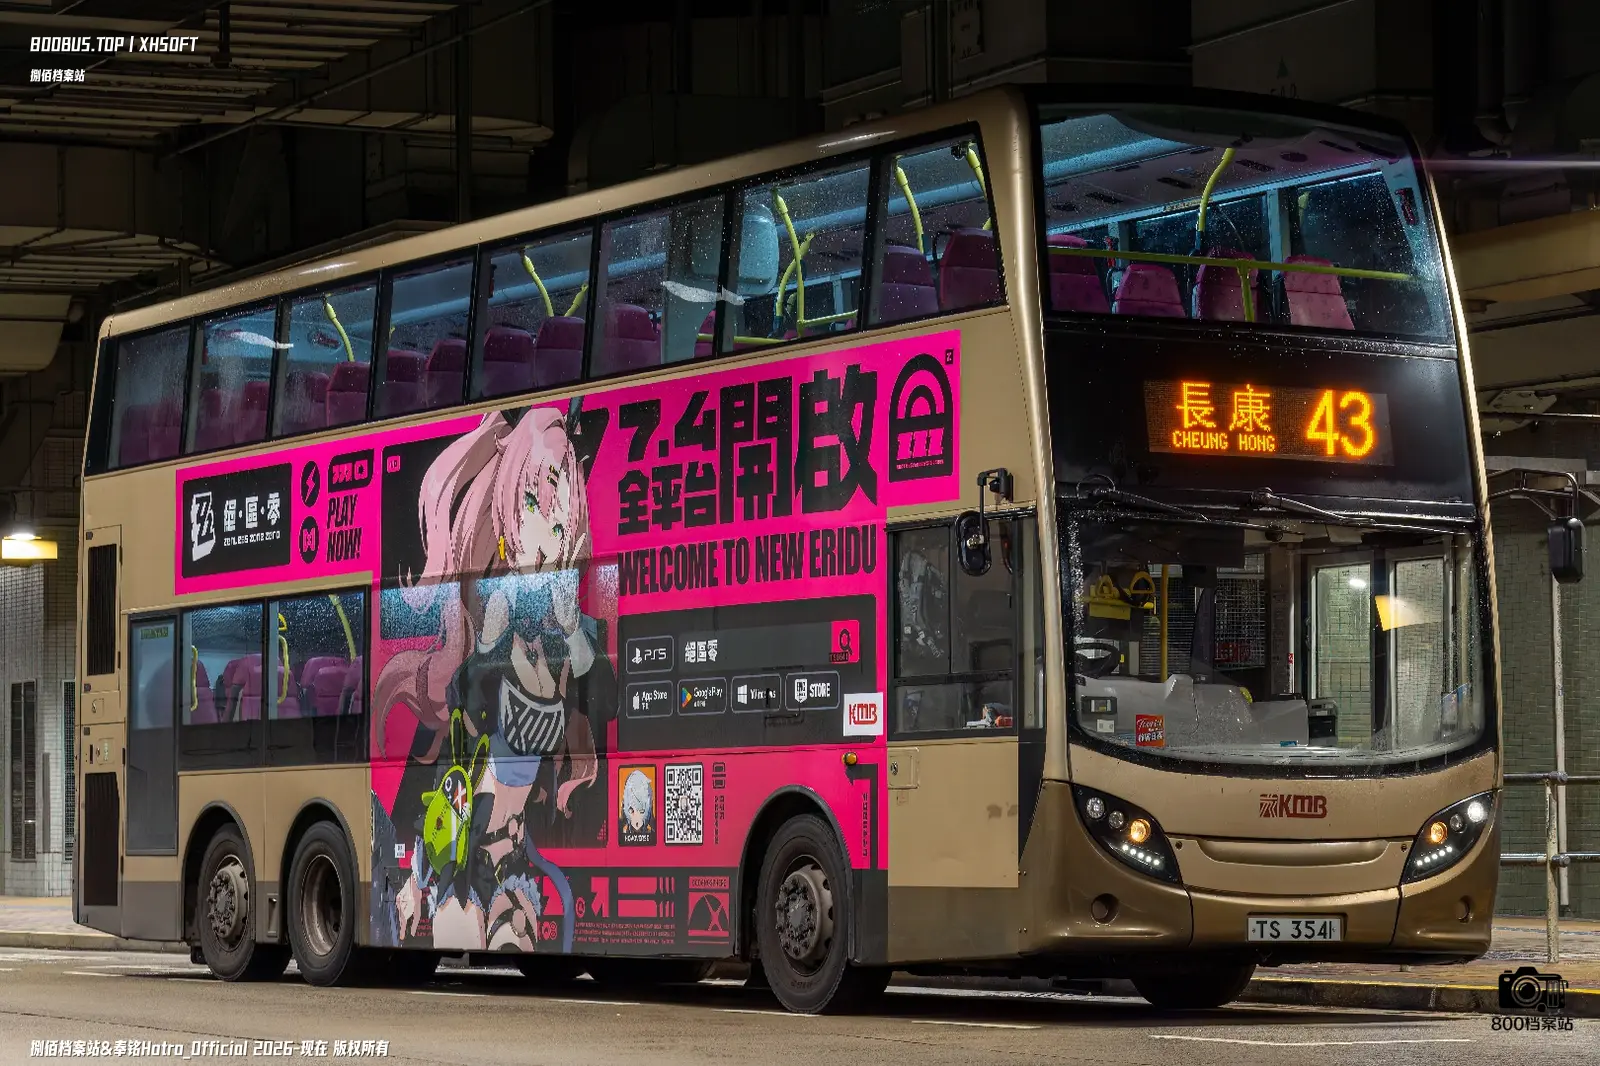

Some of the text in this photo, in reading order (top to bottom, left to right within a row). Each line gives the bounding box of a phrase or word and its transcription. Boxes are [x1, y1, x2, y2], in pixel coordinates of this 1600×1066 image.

[1176, 382, 1271, 432] 長康
[618, 390, 716, 463] 7.4
[1306, 389, 1374, 456] 43
[1172, 430, 1276, 452] CHEUNG HONG
[618, 461, 717, 536] 全平台
[327, 494, 358, 529] PLAY
[326, 527, 362, 563] NOW!
[617, 523, 877, 597] WELCOME TO NEW ERIDU
[644, 647, 668, 661] PS5
[641, 689, 668, 702] App Store
[693, 686, 711, 699] Google
[809, 682, 831, 698] STORE
[848, 703, 878, 725] KMB
[1278, 794, 1328, 819] KMB
[1256, 920, 1332, 939] TS 3541
